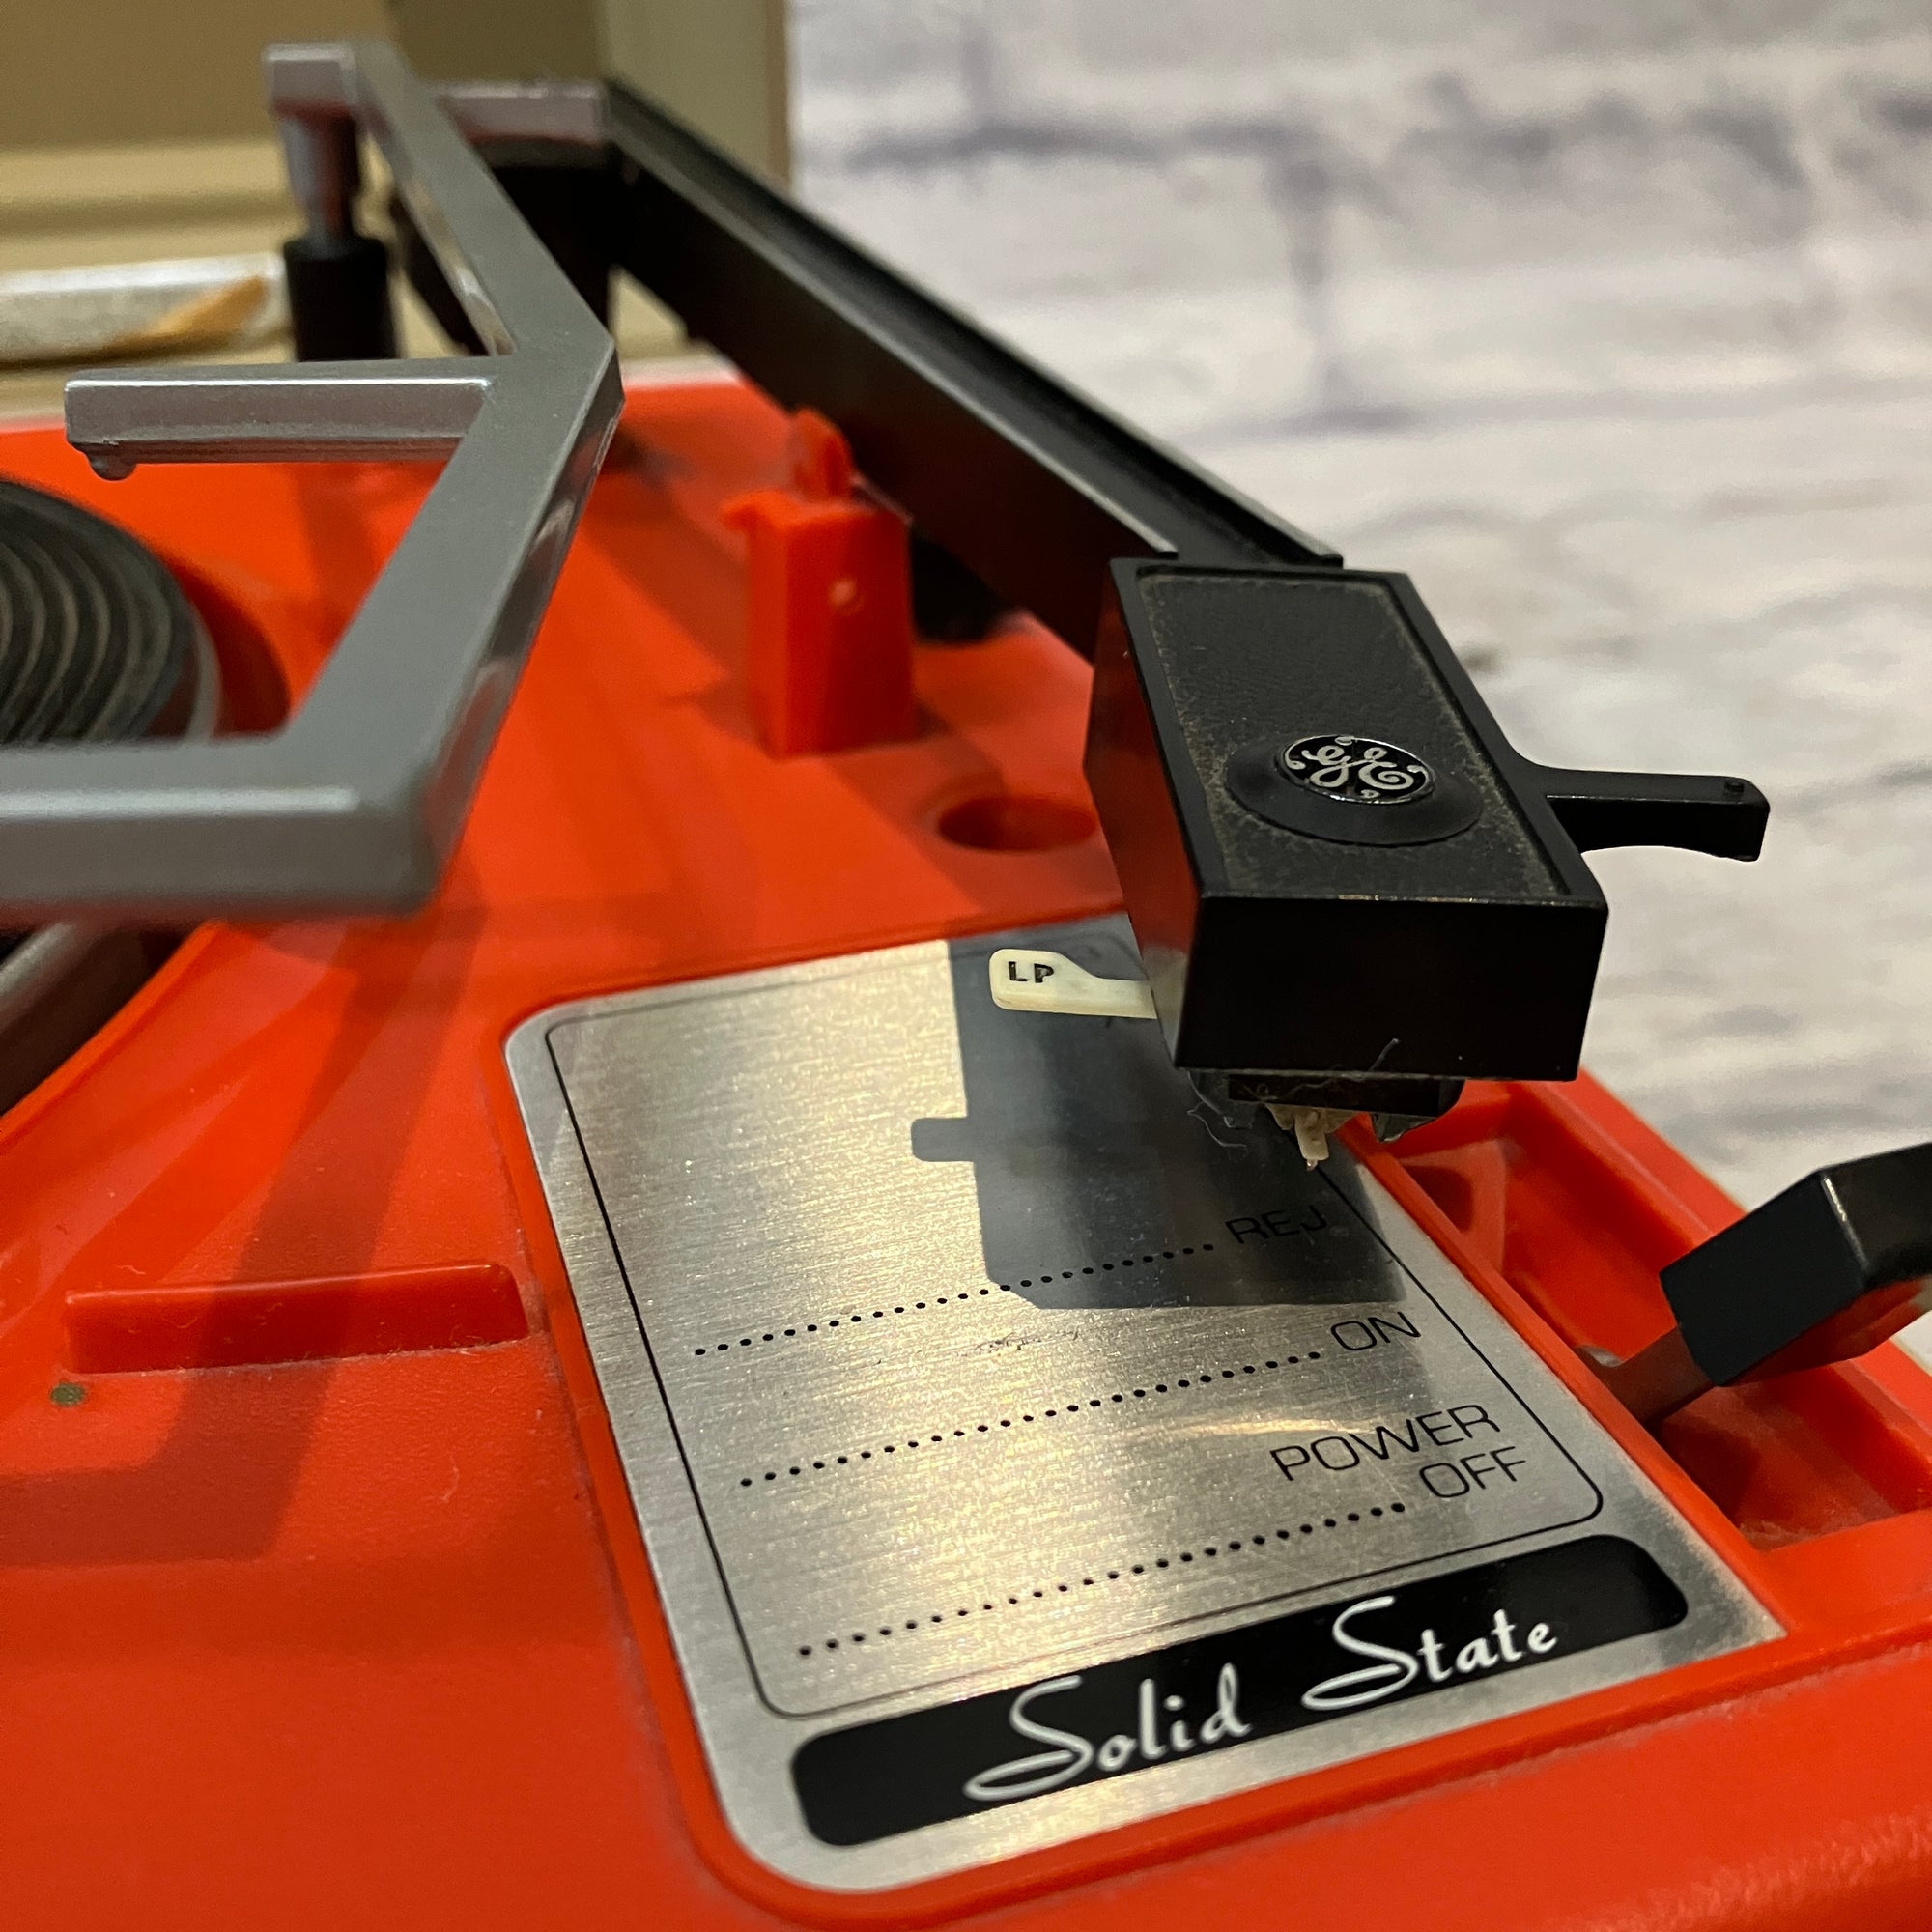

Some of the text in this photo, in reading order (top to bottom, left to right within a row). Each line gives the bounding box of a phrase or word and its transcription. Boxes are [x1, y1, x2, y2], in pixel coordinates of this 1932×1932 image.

[1009, 961, 1054, 983] LP
[1225, 1205, 1328, 1244] REJ
[1329, 1311, 1421, 1351] ON
[1270, 1404, 1500, 1481] POWER
[1418, 1446, 1527, 1499] OFF
[964, 1596, 1557, 1801] Solid State
